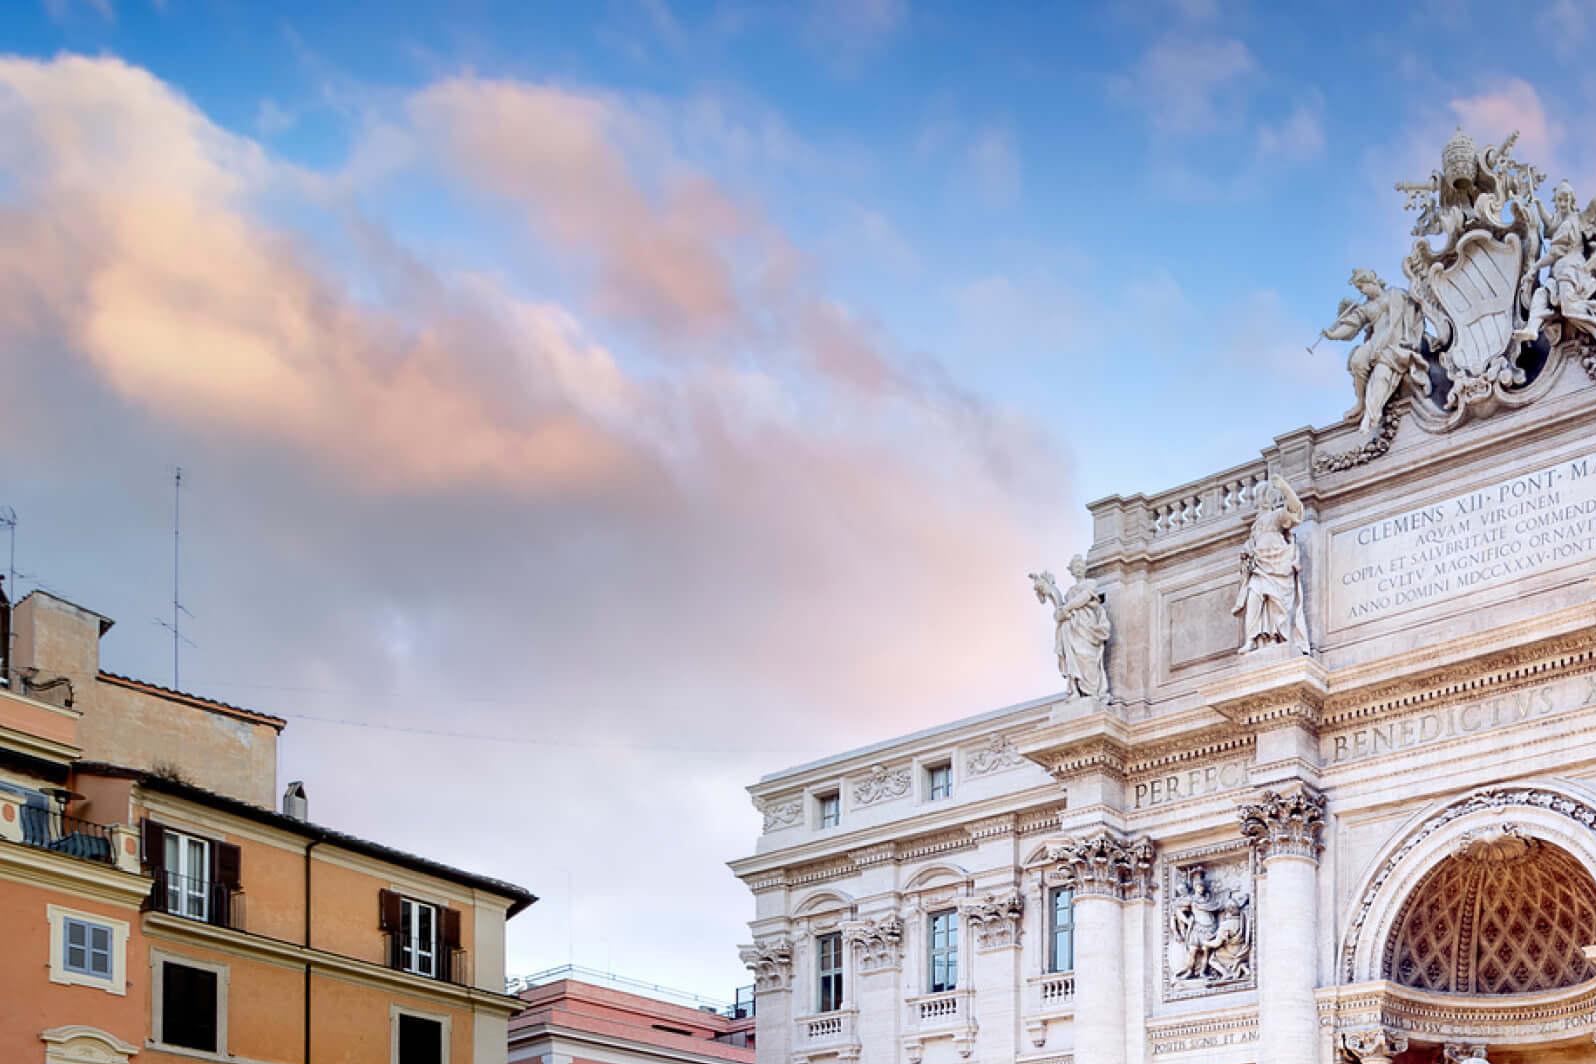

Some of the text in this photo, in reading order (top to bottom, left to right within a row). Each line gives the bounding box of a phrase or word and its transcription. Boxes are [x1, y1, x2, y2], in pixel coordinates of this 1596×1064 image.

[1357, 505, 1444, 545] CLEMENS
[1416, 492, 1560, 547] AQVAM VIRGINEM
[1342, 565, 1383, 585] COPIA
[1390, 555, 1406, 572] ET
[1411, 526, 1506, 565] SALVBRITATE
[1433, 540, 1521, 577] MAGNIFICO
[1348, 597, 1391, 618] ANNO
[1395, 579, 1449, 605] DOMINI
[1333, 686, 1554, 764] BENEDICTVS
